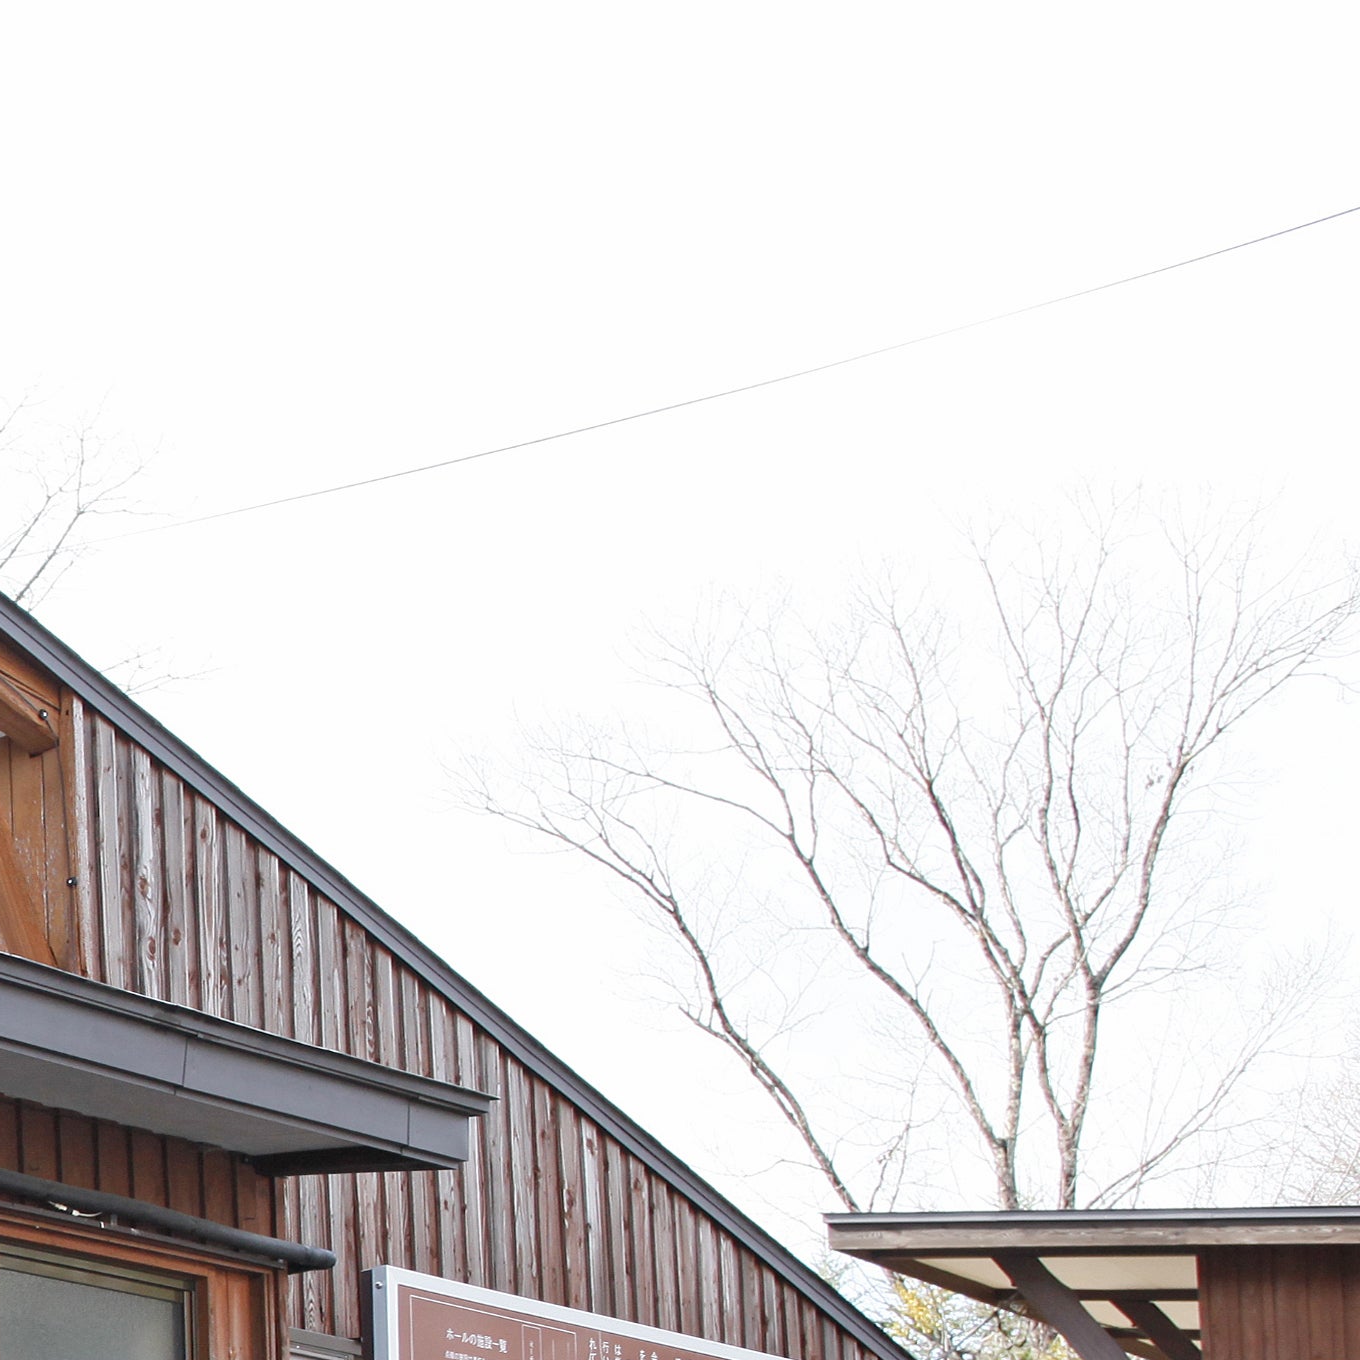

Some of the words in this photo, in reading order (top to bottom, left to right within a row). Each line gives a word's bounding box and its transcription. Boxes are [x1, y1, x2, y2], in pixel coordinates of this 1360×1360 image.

[445, 1328, 508, 1353] ホールの施設一覧
